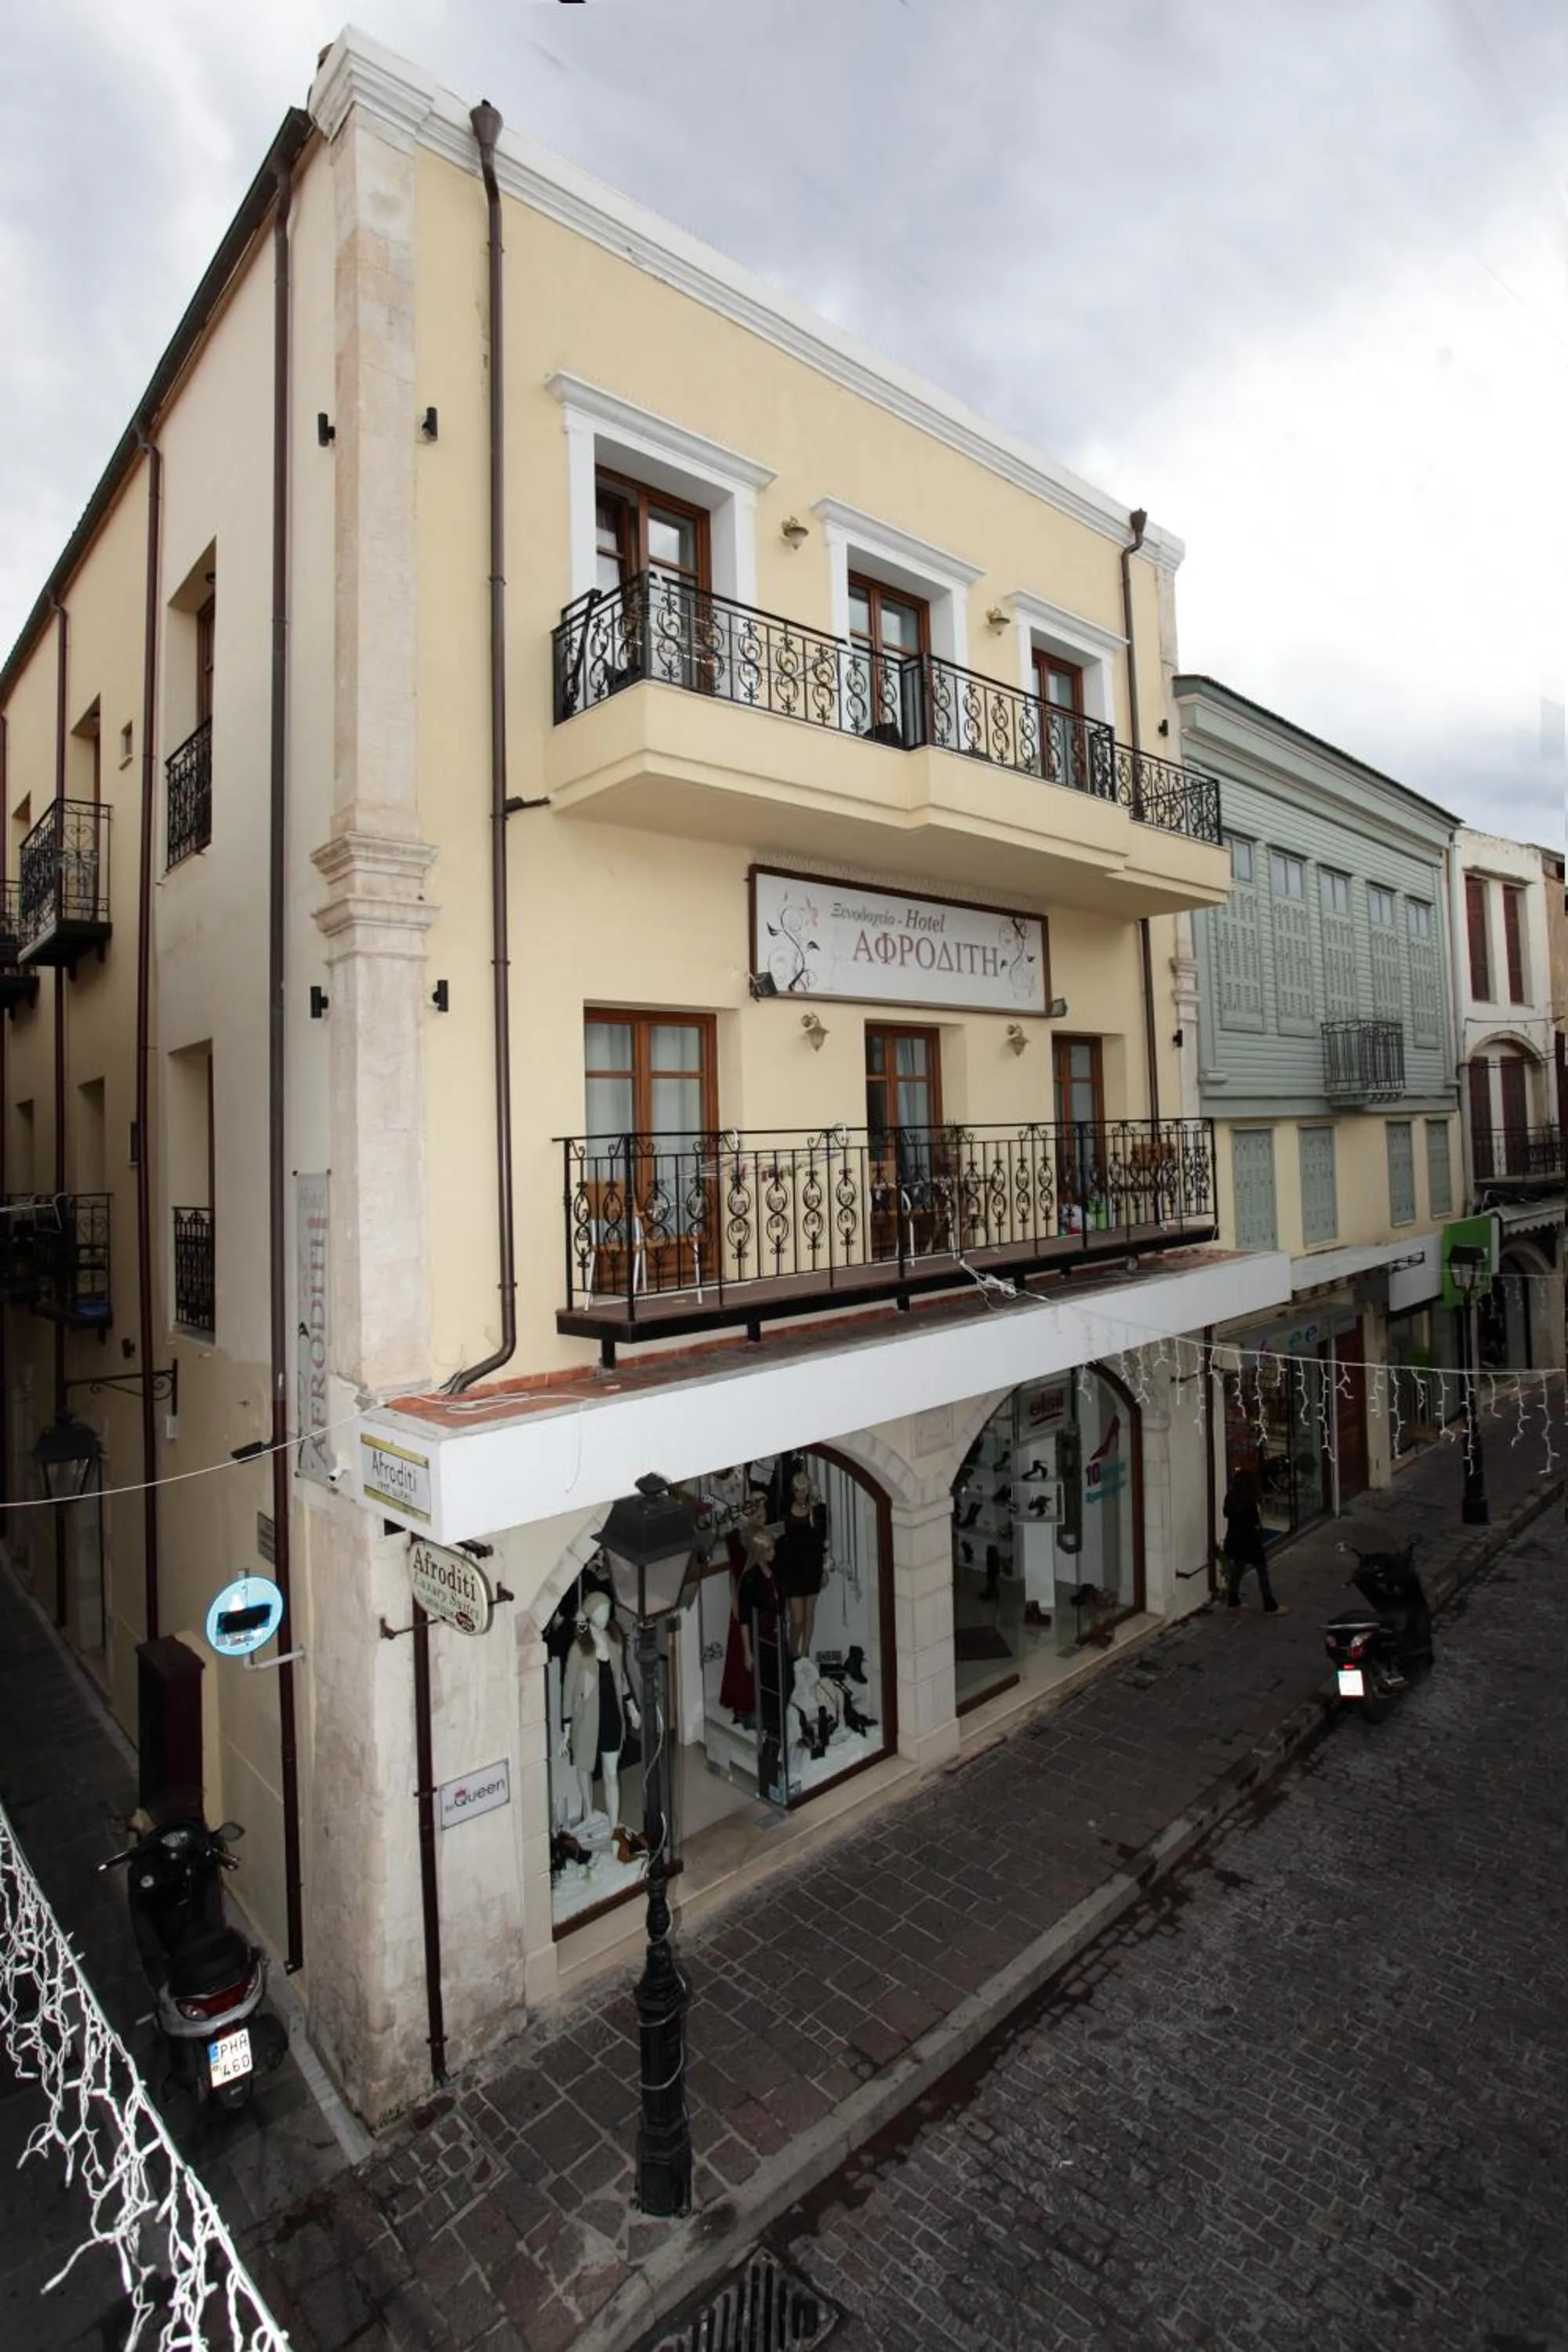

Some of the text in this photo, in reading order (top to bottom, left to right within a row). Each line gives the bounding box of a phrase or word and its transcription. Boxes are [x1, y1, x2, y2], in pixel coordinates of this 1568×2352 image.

[906, 909, 946, 933] Hotel
[852, 929, 1000, 977] ΑΦΡΟΔΙΤΗ
[308, 1238, 328, 1465] AFRODITI
[1085, 1462, 1101, 1486] 10
[413, 1547, 476, 1602] Afroditi
[454, 1779, 505, 1806] Queen
